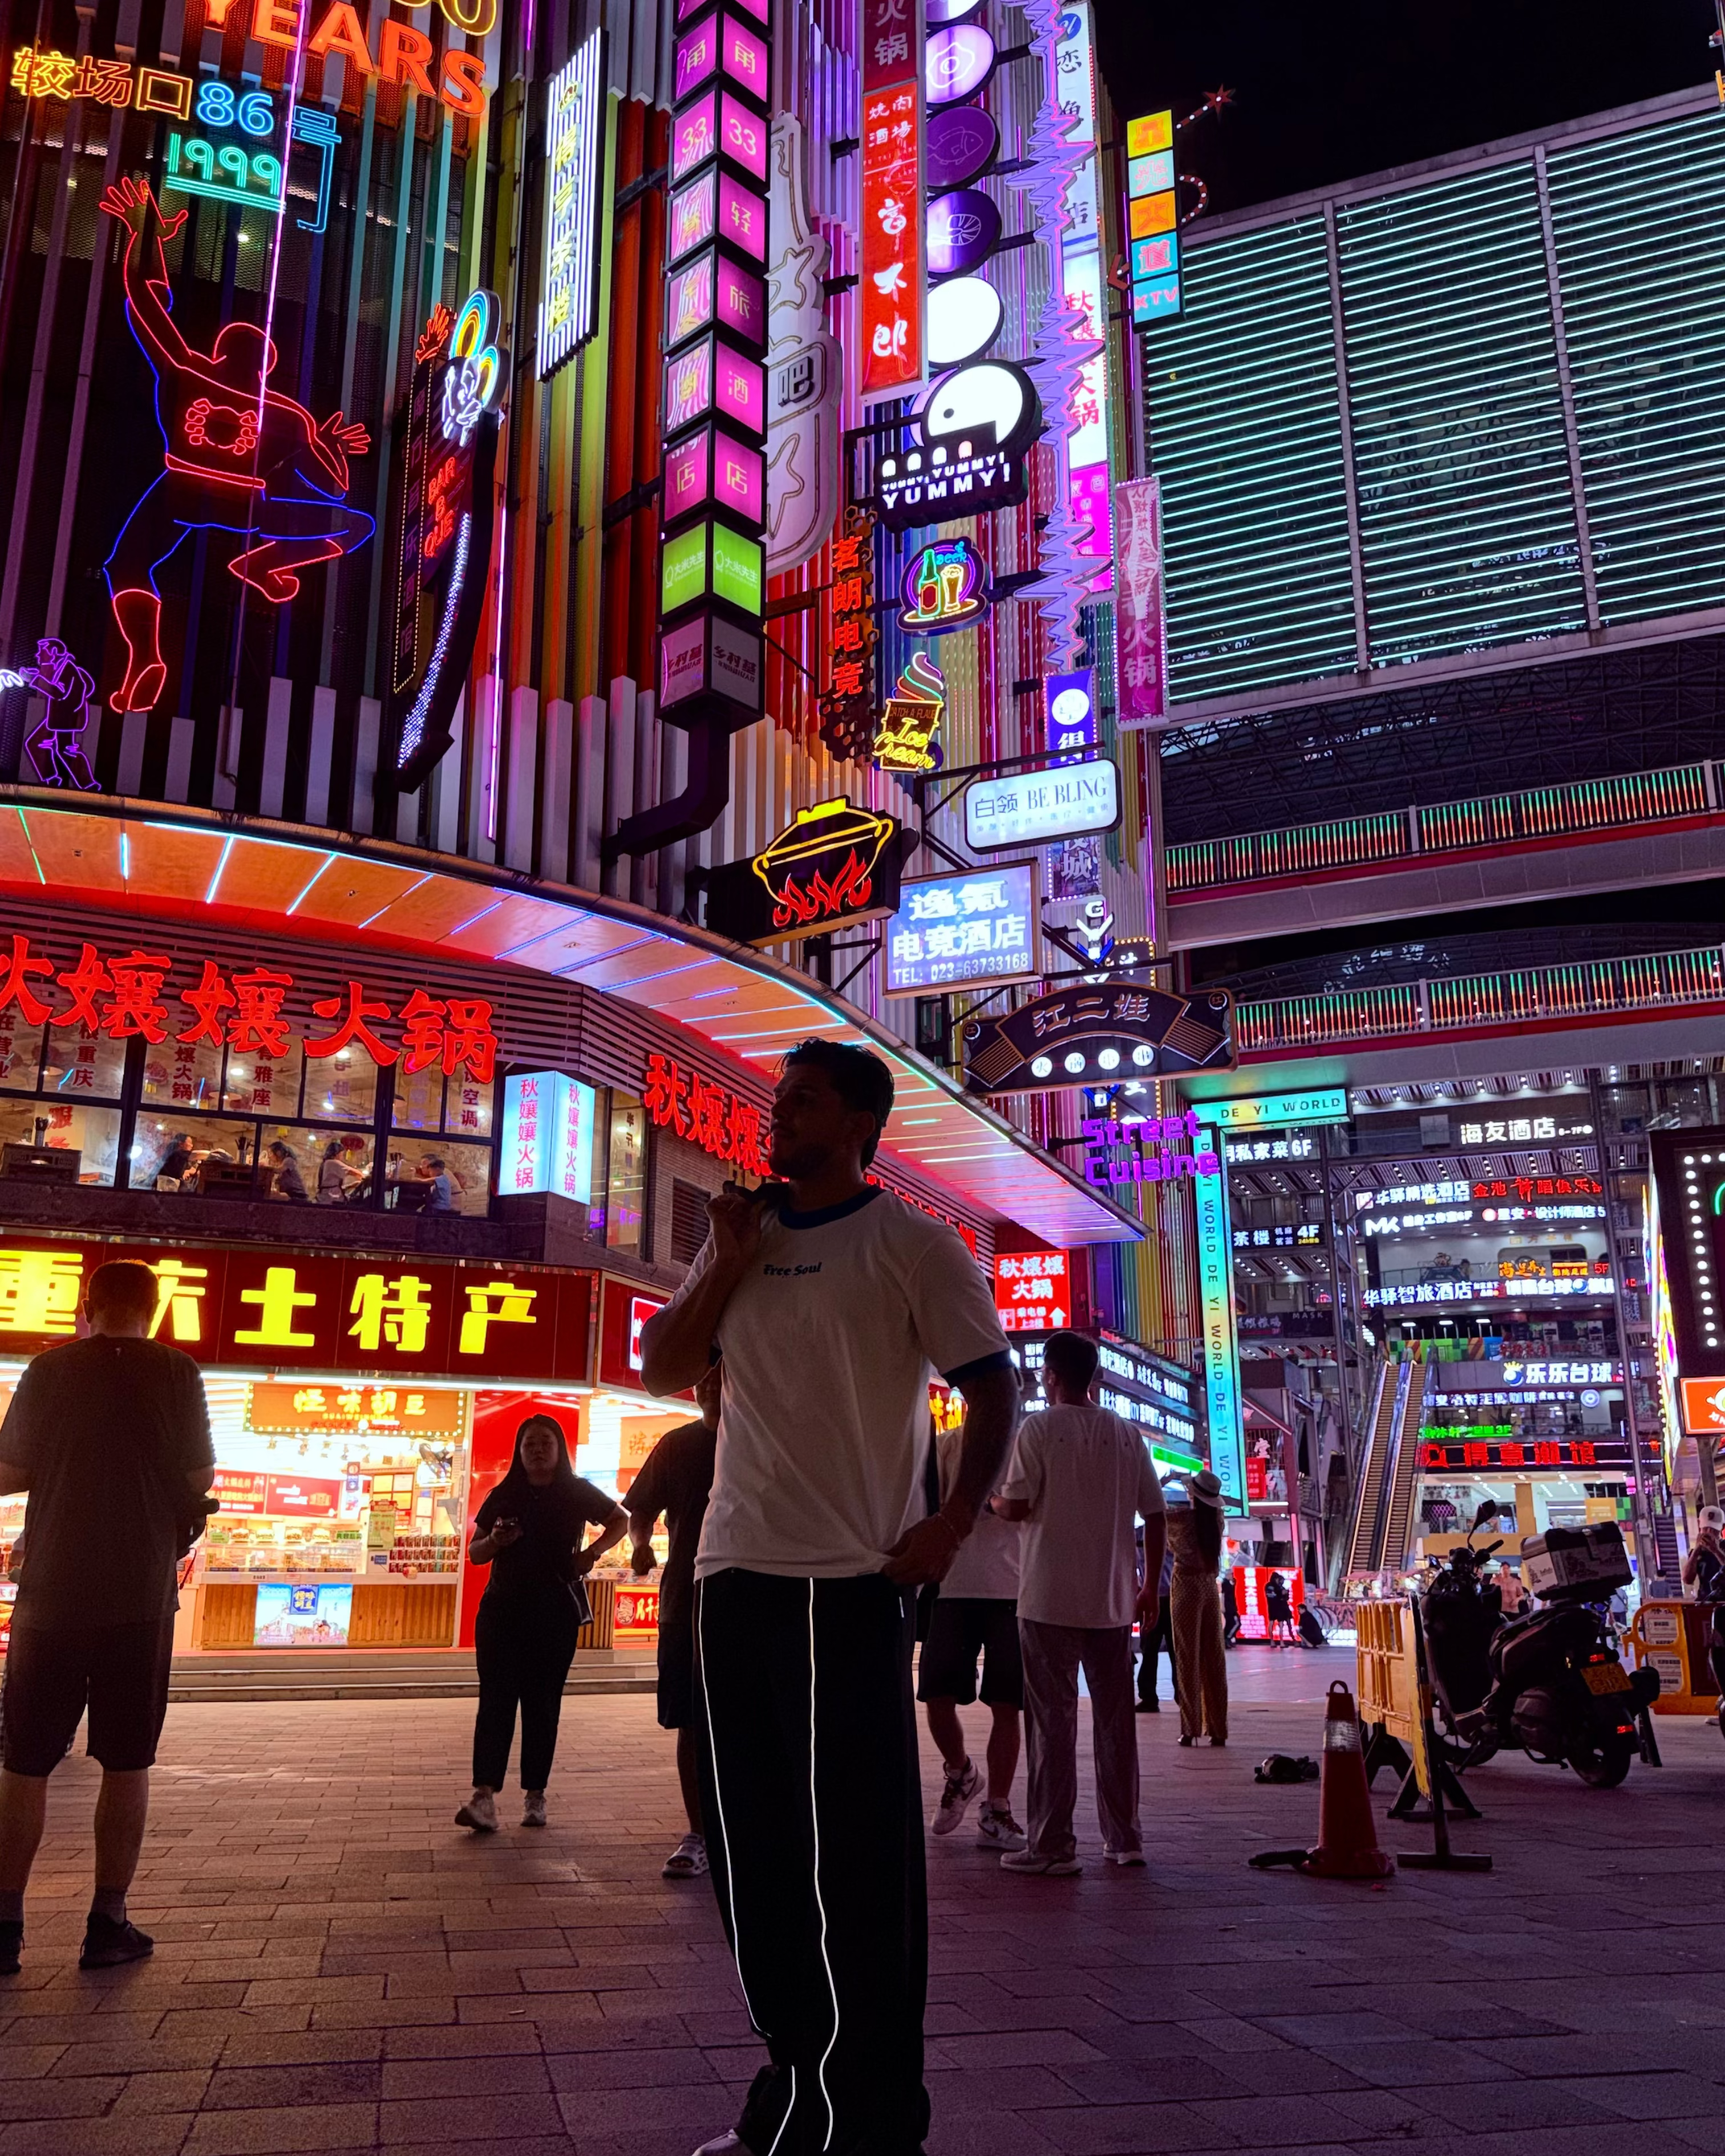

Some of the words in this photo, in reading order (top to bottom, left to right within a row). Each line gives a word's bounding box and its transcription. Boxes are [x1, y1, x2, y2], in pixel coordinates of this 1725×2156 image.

[168, 134, 281, 195] 1999
[1134, 286, 1178, 311] KTV
[428, 456, 456, 505] BAR
[882, 475, 930, 492] YUMMY!
[932, 451, 1005, 479] YUMMY!
[882, 462, 1011, 510] YUMMY!
[435, 495, 446, 518] B
[424, 509, 455, 558] QUE
[724, 556, 758, 583] 大米先生
[832, 535, 866, 699] 茗朗电竞
[713, 645, 757, 675] 乡村基
[893, 717, 929, 748] Ice
[872, 731, 936, 769] Cream
[975, 793, 1018, 819] 白领
[1027, 787, 1050, 810] BE
[1055, 776, 1107, 805] BLING
[893, 913, 1027, 962] 电竞酒店
[893, 967, 923, 984] TEL:
[930, 953, 1028, 981] 023-63733168
[1221, 1108, 1240, 1118] DE
[1253, 1105, 1269, 1115] YI
[1282, 1097, 1341, 1112] WORLD
[515, 1077, 539, 1189] 秋嬢嬢火锅
[564, 1083, 580, 1195] 秋嬢嬢火锅
[1083, 1110, 1201, 1149] Street
[1460, 1117, 1556, 1145] 海友酒店
[1291, 1139, 1313, 1157] 6F
[1085, 1148, 1220, 1186] Cuisine
[1202, 1199, 1217, 1254] WORLD
[1233, 1229, 1270, 1247] 茶楼
[1297, 1225, 1320, 1238] 4F
[1365, 1215, 1401, 1237] MK
[763, 1264, 791, 1276] Free
[793, 1262, 822, 1276] Soul
[999, 1255, 1065, 1279] 秋嬢嬢
[1208, 1264, 1219, 1282] DE
[1594, 1263, 1609, 1274] 5F
[0, 1250, 537, 1354] 重庆土特产
[1011, 1279, 1054, 1300] 火锅
[1209, 1296, 1220, 1311] YI
[1362, 1281, 1473, 1308] 华驿智旅酒店
[1212, 1324, 1224, 1380] WORLD
[1525, 1361, 1613, 1384] 乐乐台球
[293, 1388, 426, 1416] 怪味胡豆
[1216, 1392, 1226, 1412] DE
[1217, 1426, 1228, 1441] YI
[1464, 1441, 1596, 1467] 得意潮馆
